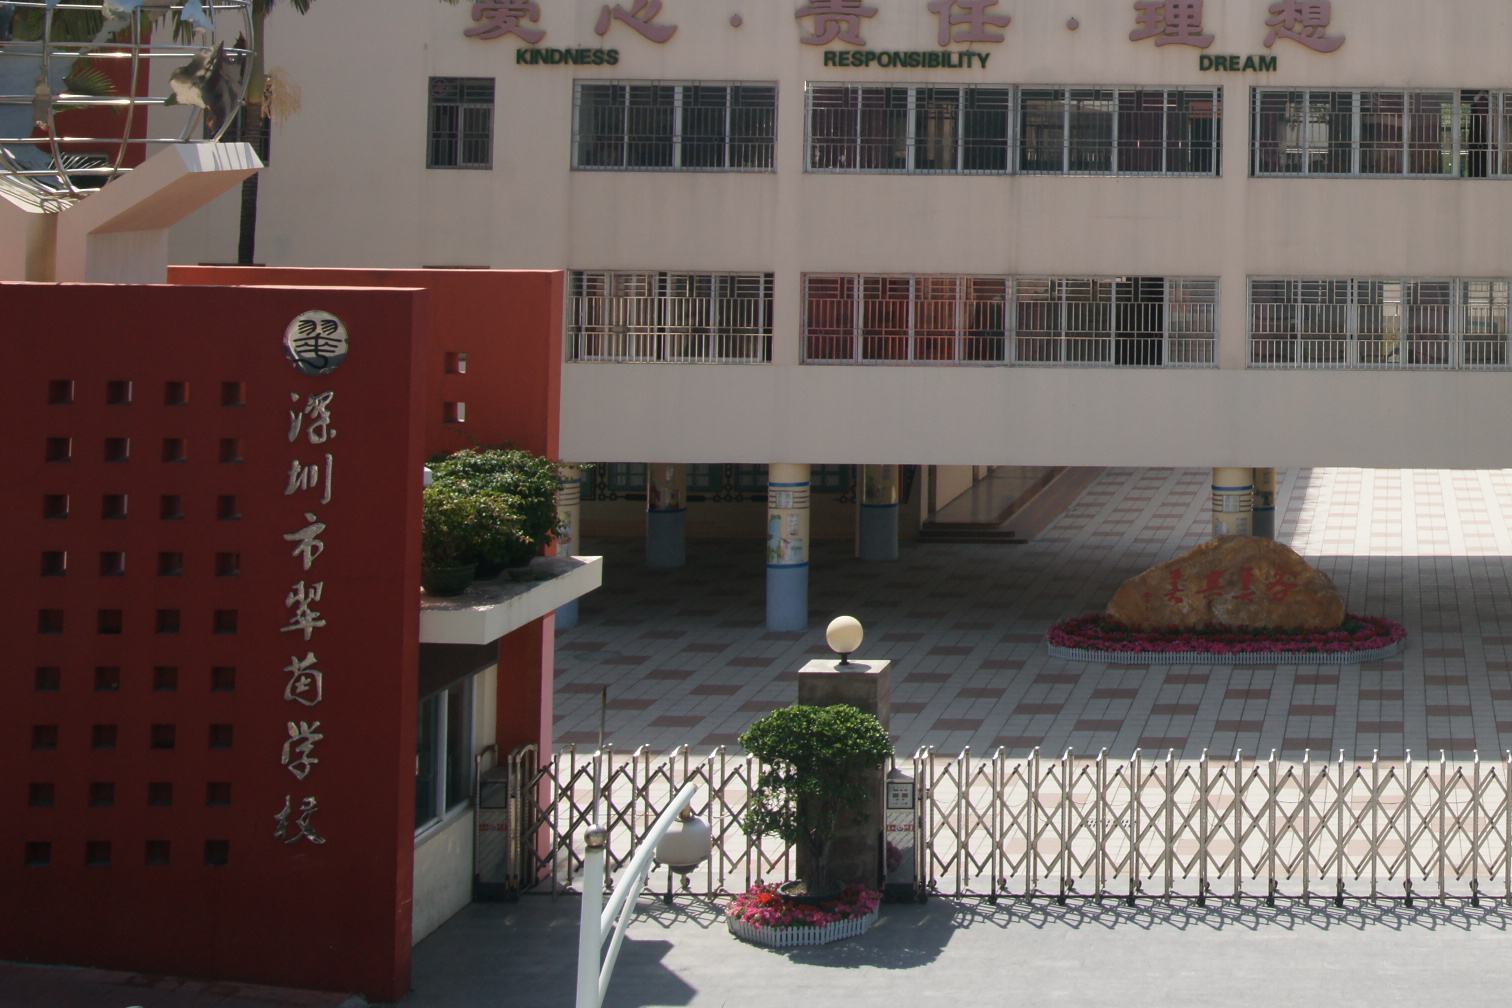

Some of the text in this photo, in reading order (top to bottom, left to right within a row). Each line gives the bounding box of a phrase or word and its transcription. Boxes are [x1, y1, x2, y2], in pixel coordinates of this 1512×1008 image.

[516, 48, 1278, 72] KINDNESS RESPONSIBILITY DREAM
[273, 390, 337, 847] 深圳市翠茵学校
